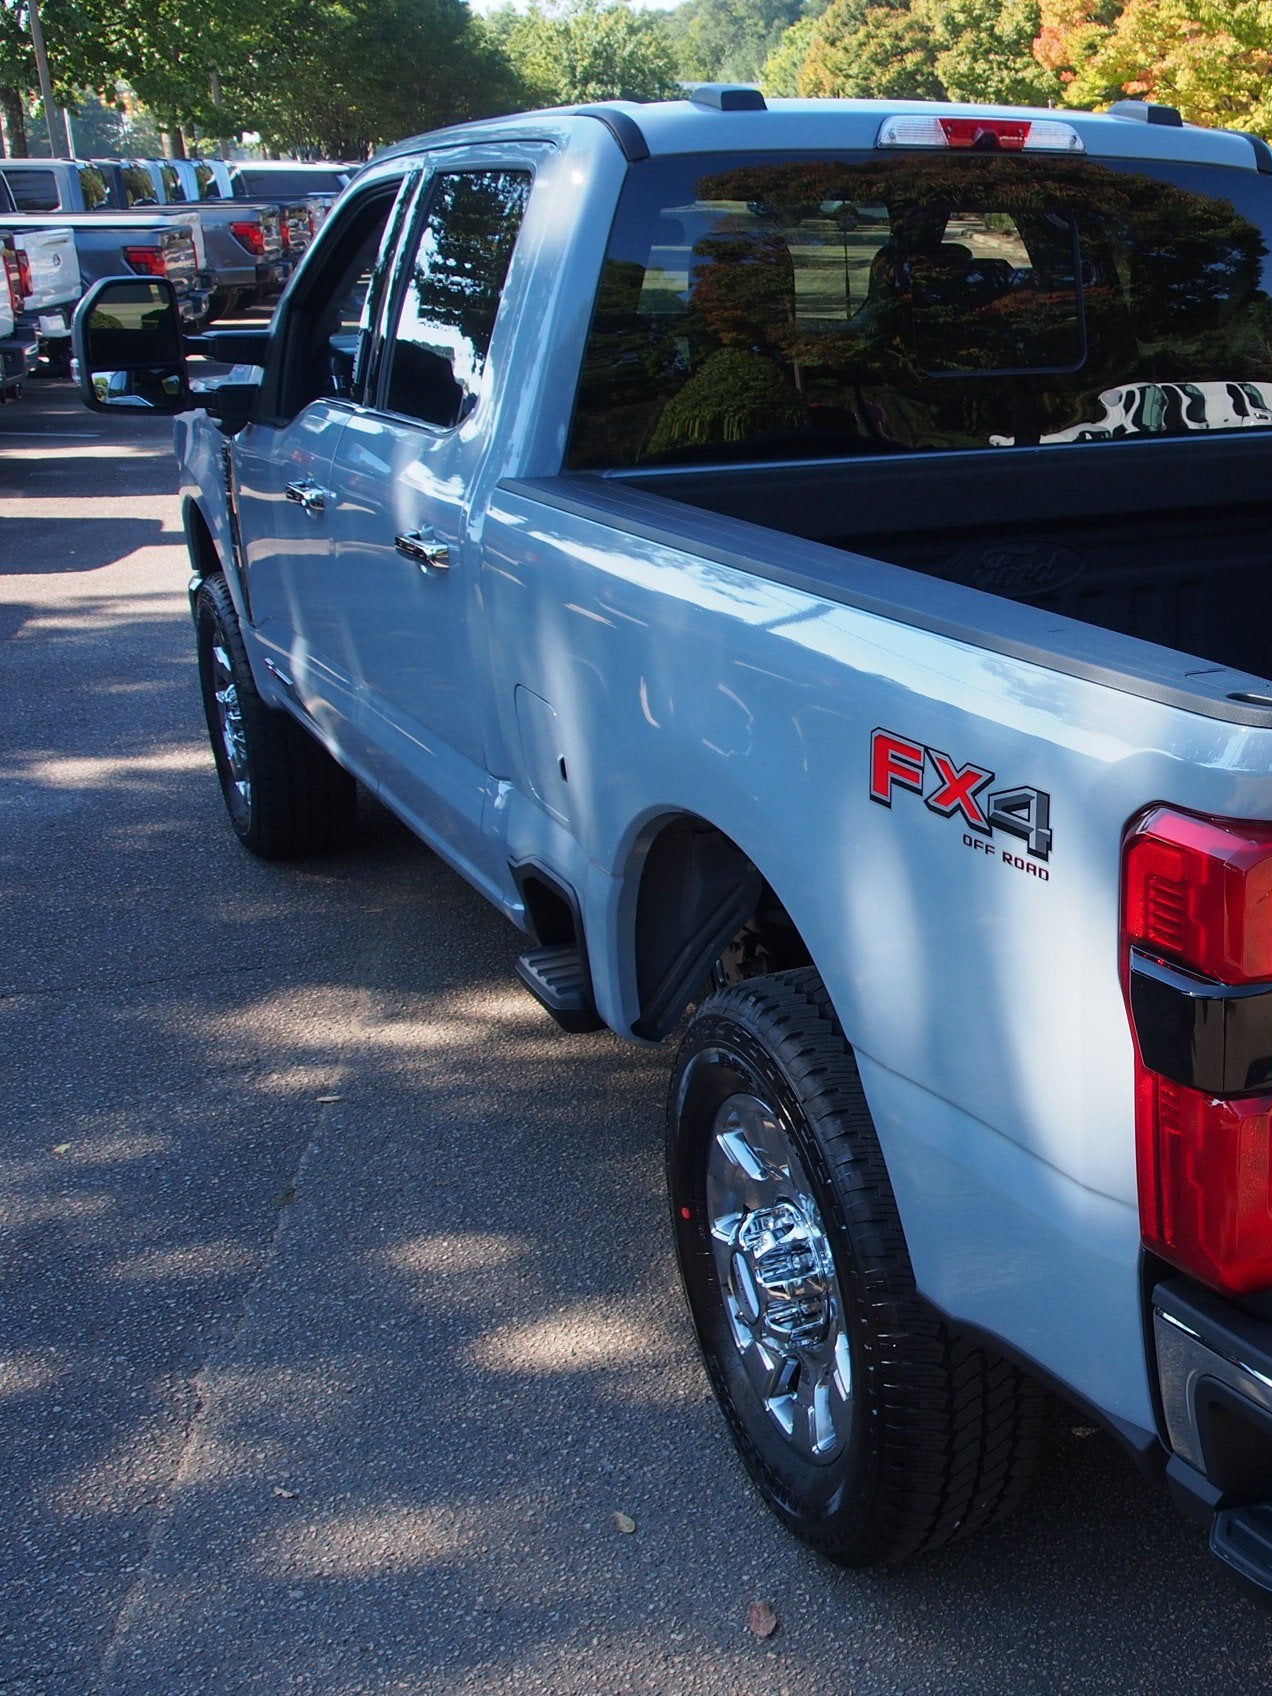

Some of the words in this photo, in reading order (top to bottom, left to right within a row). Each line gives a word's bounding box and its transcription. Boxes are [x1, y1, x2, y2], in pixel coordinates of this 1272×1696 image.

[971, 544, 1058, 585] Ford
[869, 727, 1053, 863] FX4
[962, 833, 996, 855] OFF
[1002, 851, 1050, 882] ROAD
